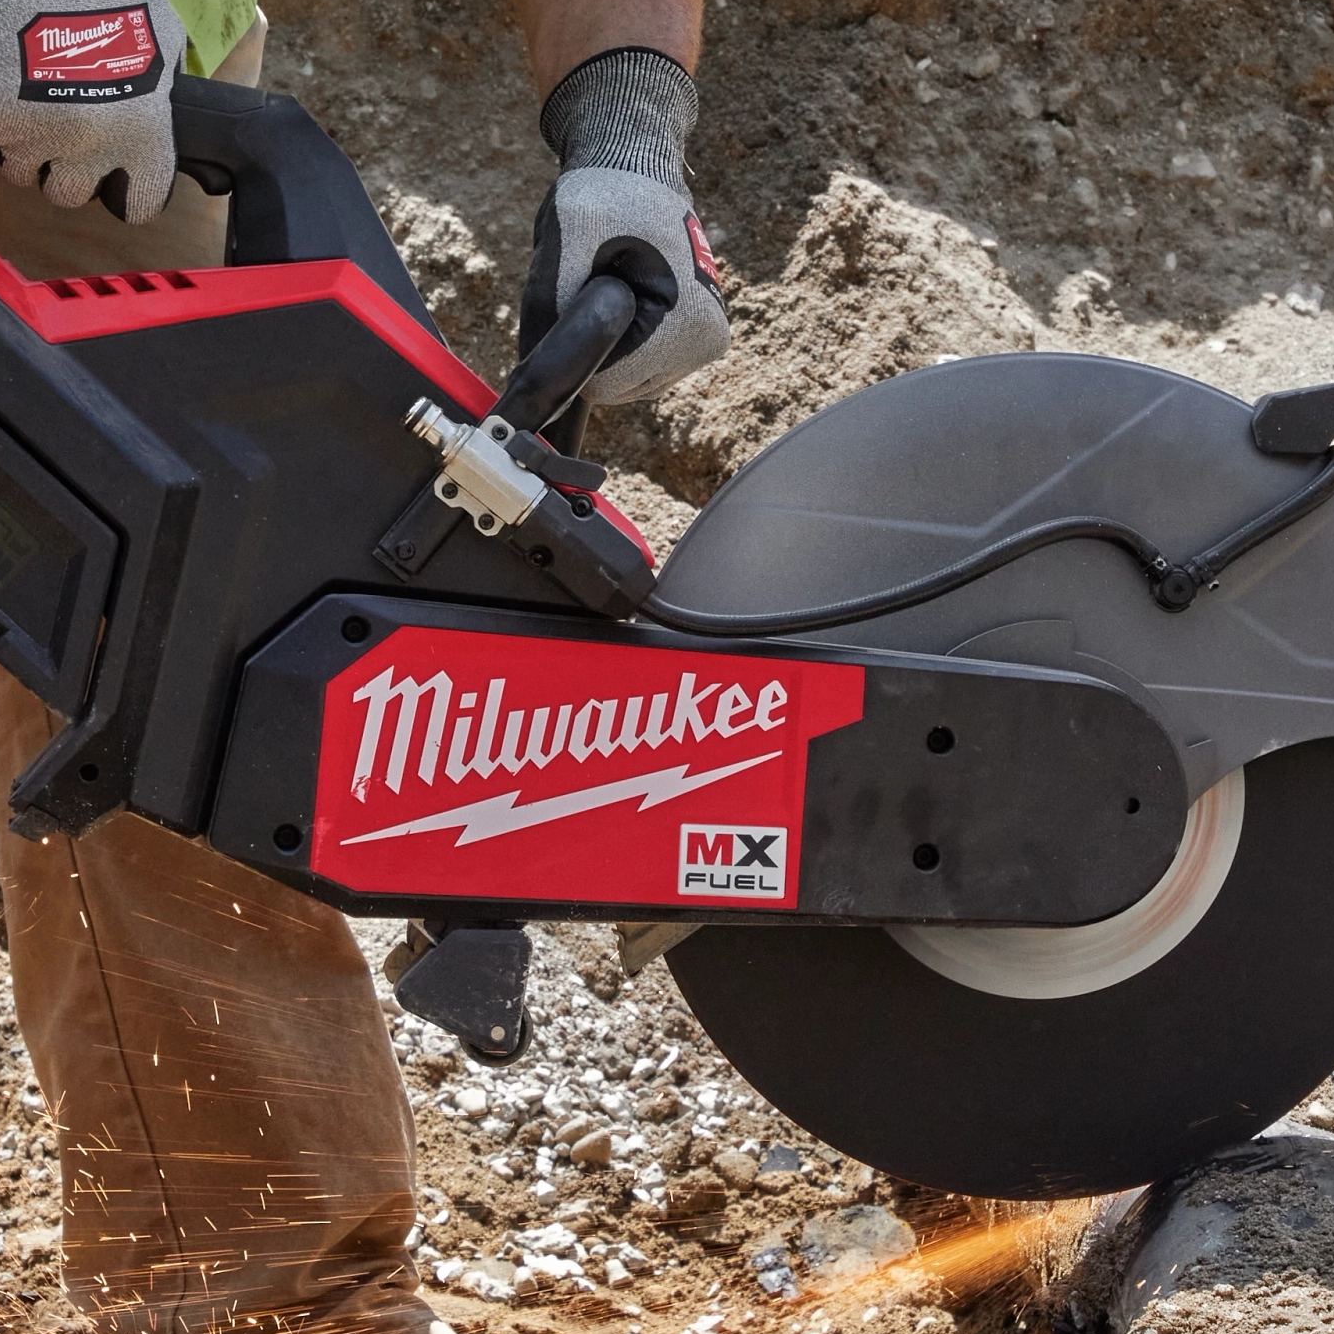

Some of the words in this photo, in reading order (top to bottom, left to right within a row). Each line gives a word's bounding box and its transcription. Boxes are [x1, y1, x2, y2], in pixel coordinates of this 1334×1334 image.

[48, 87, 76, 97] CUT
[79, 87, 121, 97] LEVEL
[123, 84, 133, 93] 3
[351, 665, 788, 804] Milwaukee
[686, 832, 779, 869] MX
[685, 872, 779, 892] FUEL
